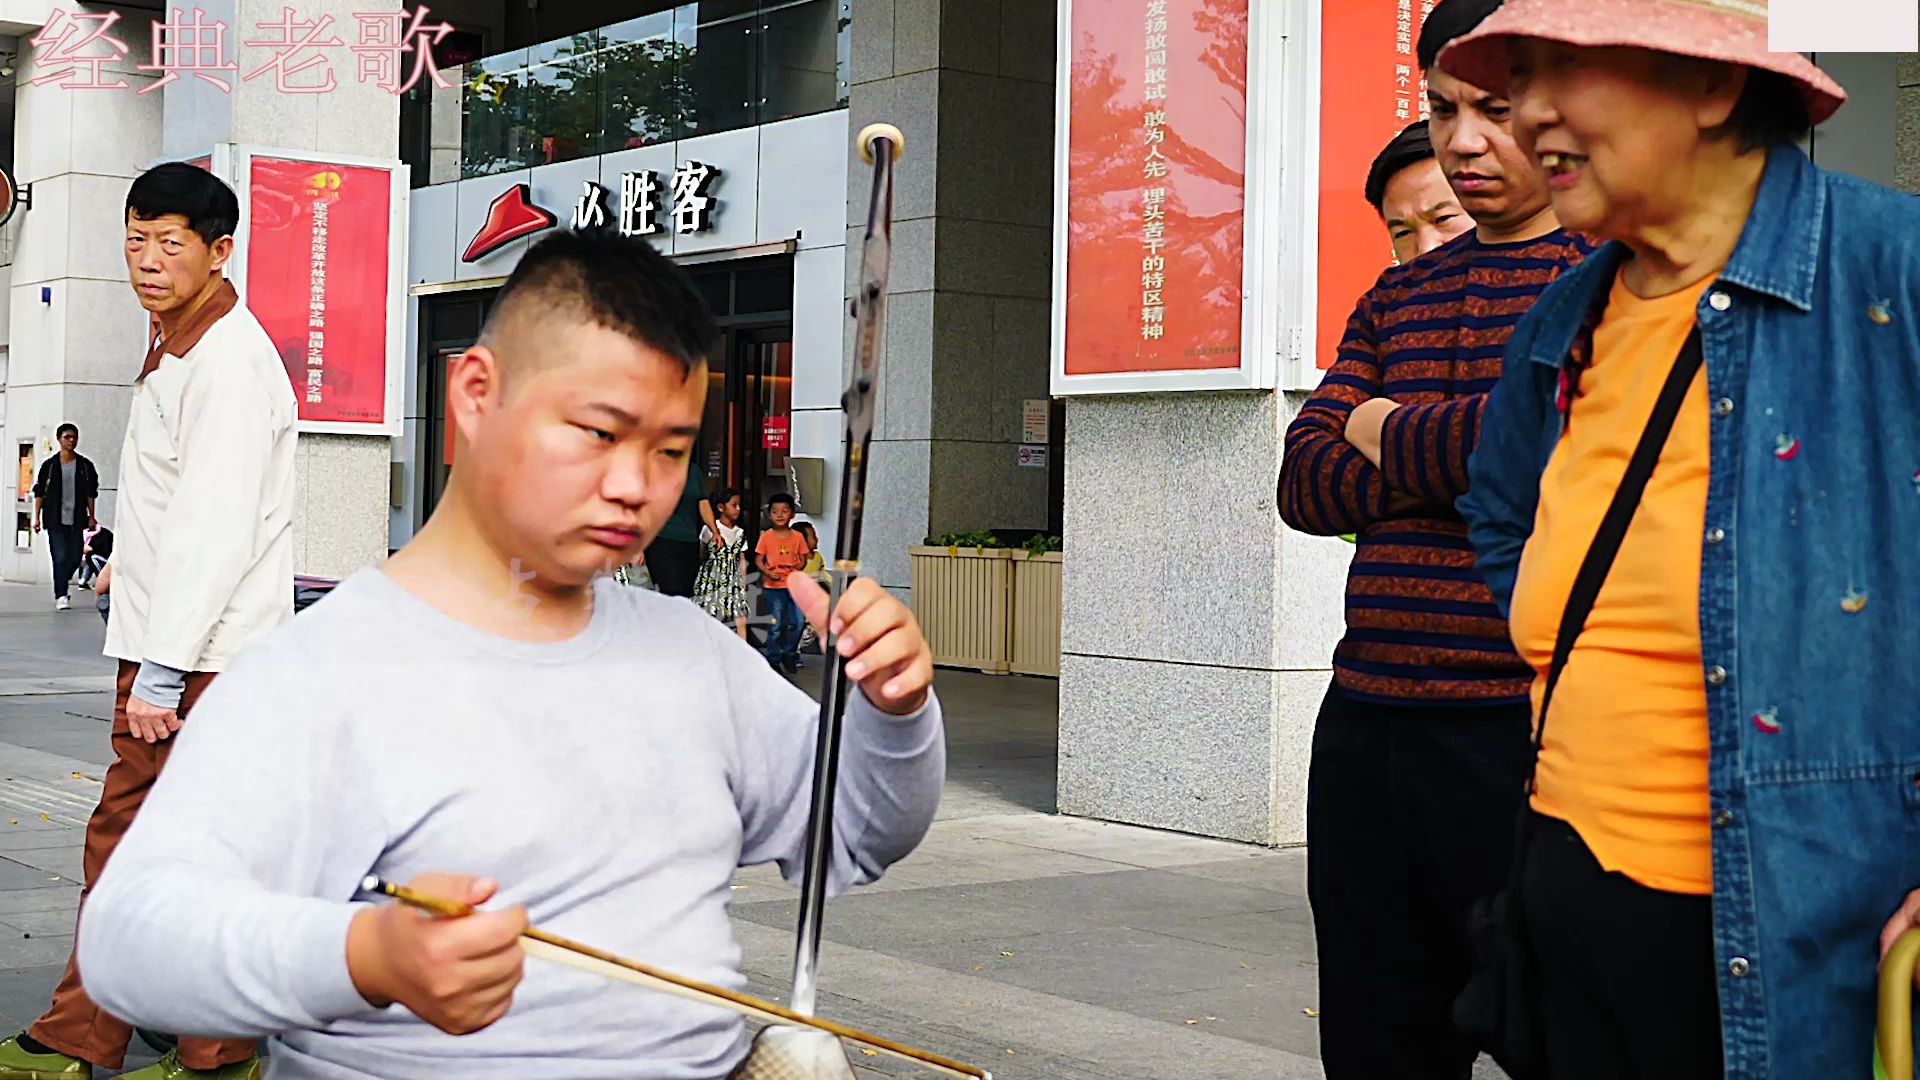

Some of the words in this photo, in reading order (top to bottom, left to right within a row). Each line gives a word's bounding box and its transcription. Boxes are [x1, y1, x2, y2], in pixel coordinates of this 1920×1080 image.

[1143, 0, 1168, 102] 发扬敢闯敢试
[1394, 64, 1411, 120] 两个一百年
[1142, 109, 1167, 179] 敢为人先
[570, 160, 710, 238] 必胜客
[1141, 187, 1166, 342] 埋头苦干的特区精神
[307, 331, 325, 366] 强国之路
